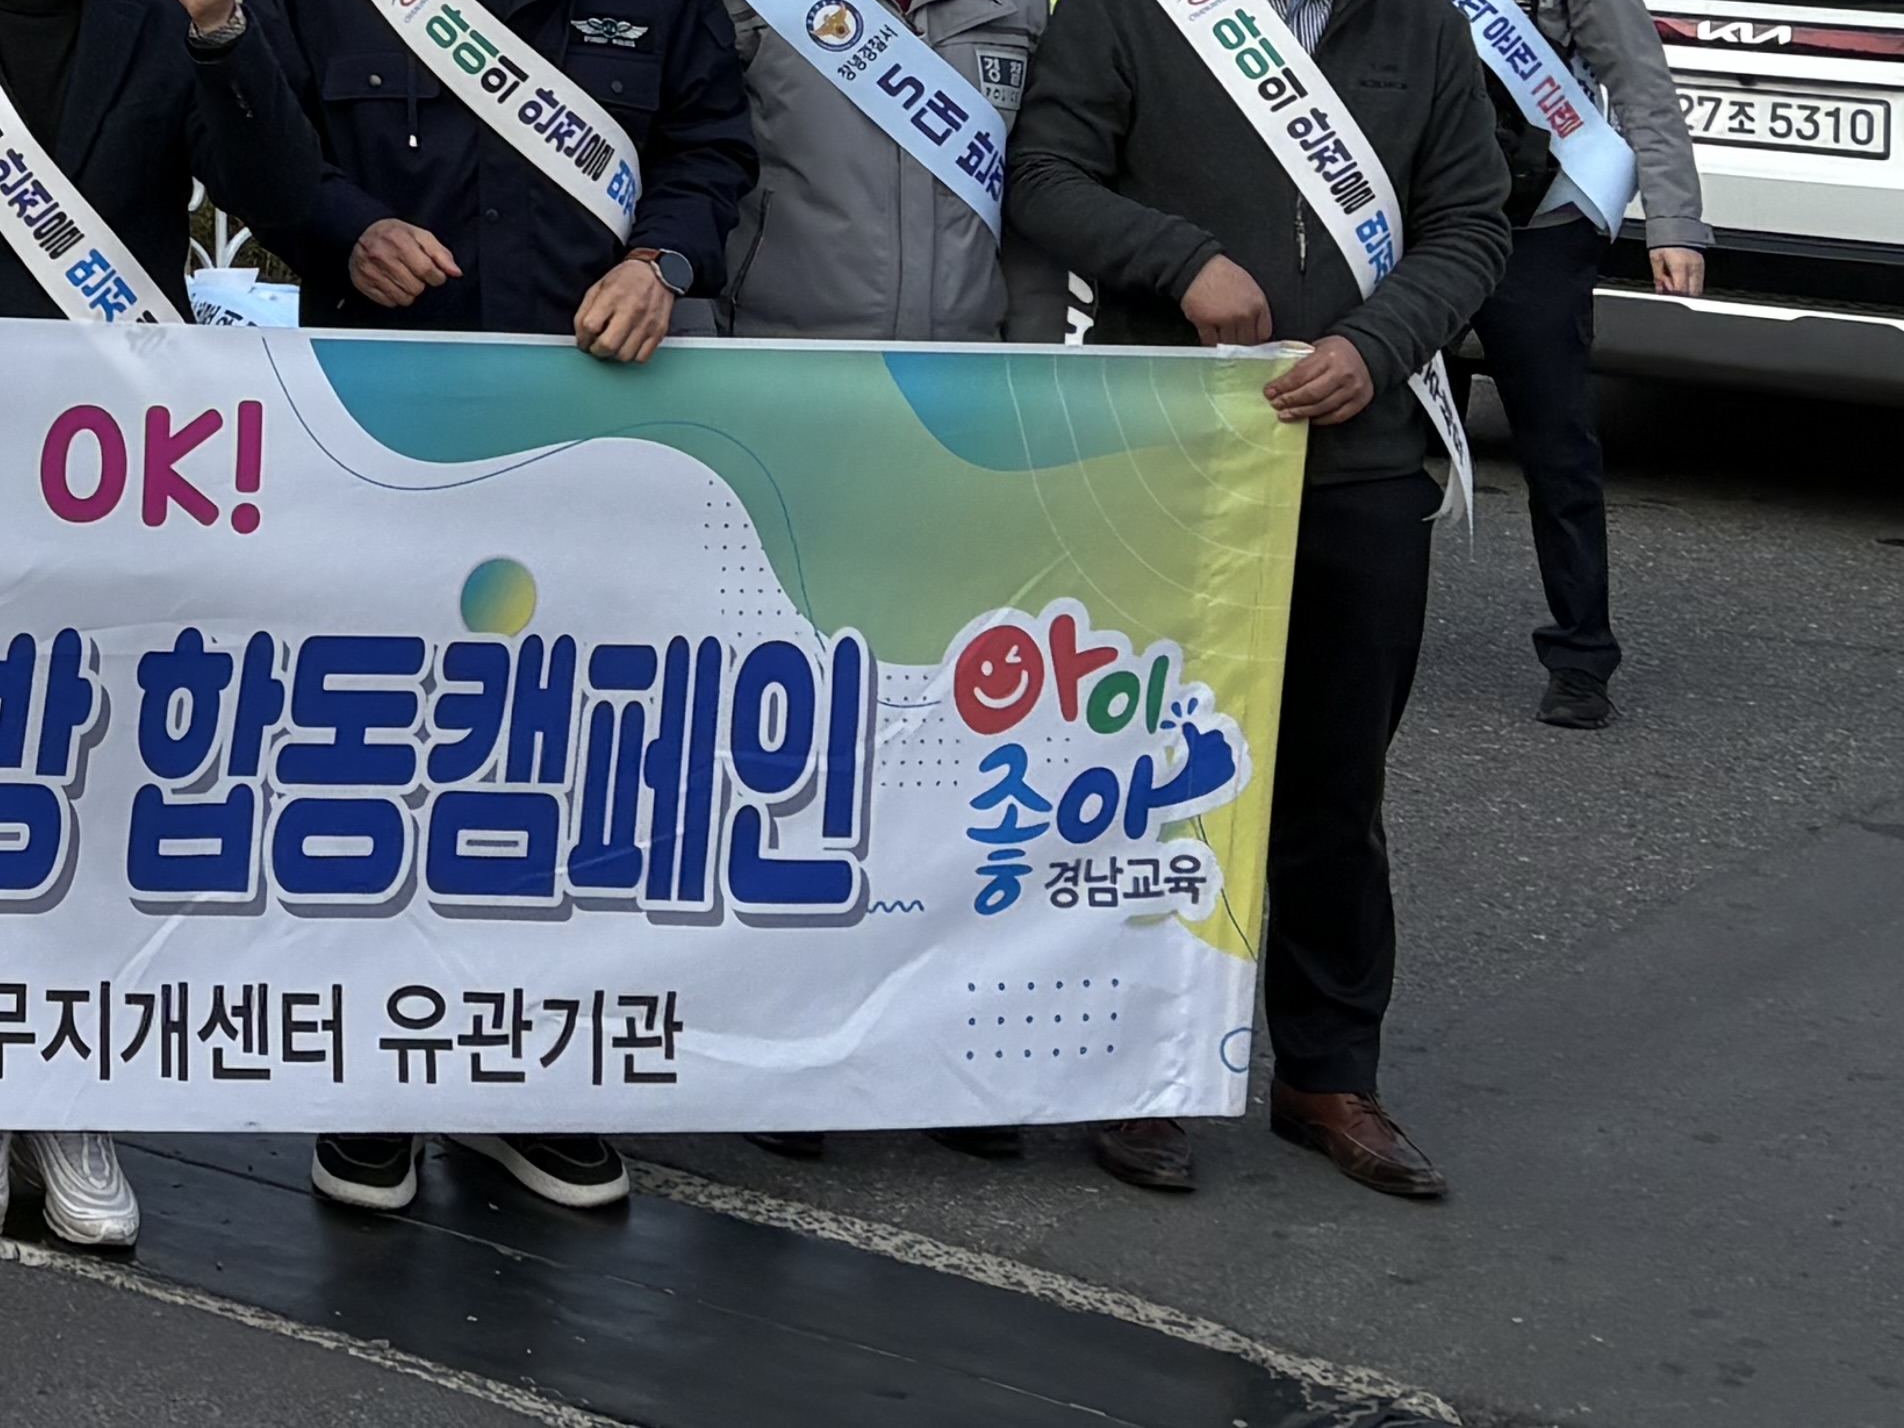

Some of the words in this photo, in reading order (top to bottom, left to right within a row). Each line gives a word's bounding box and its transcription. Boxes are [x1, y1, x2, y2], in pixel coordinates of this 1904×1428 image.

[426, 3, 530, 104] 아이의
[517, 87, 615, 182] 안전을
[876, 62, 970, 147] 5대
[1212, 8, 1308, 113] 아이의
[1286, 107, 1377, 216] 안전을
[1768, 101, 1875, 146] 5310
[65, 248, 138, 323] 먼저
[39, 399, 264, 534] OK!
[125, 627, 858, 906] 합동캠페인
[1044, 854, 1208, 909] 경남교육
[377, 988, 683, 1087] 유관기관
